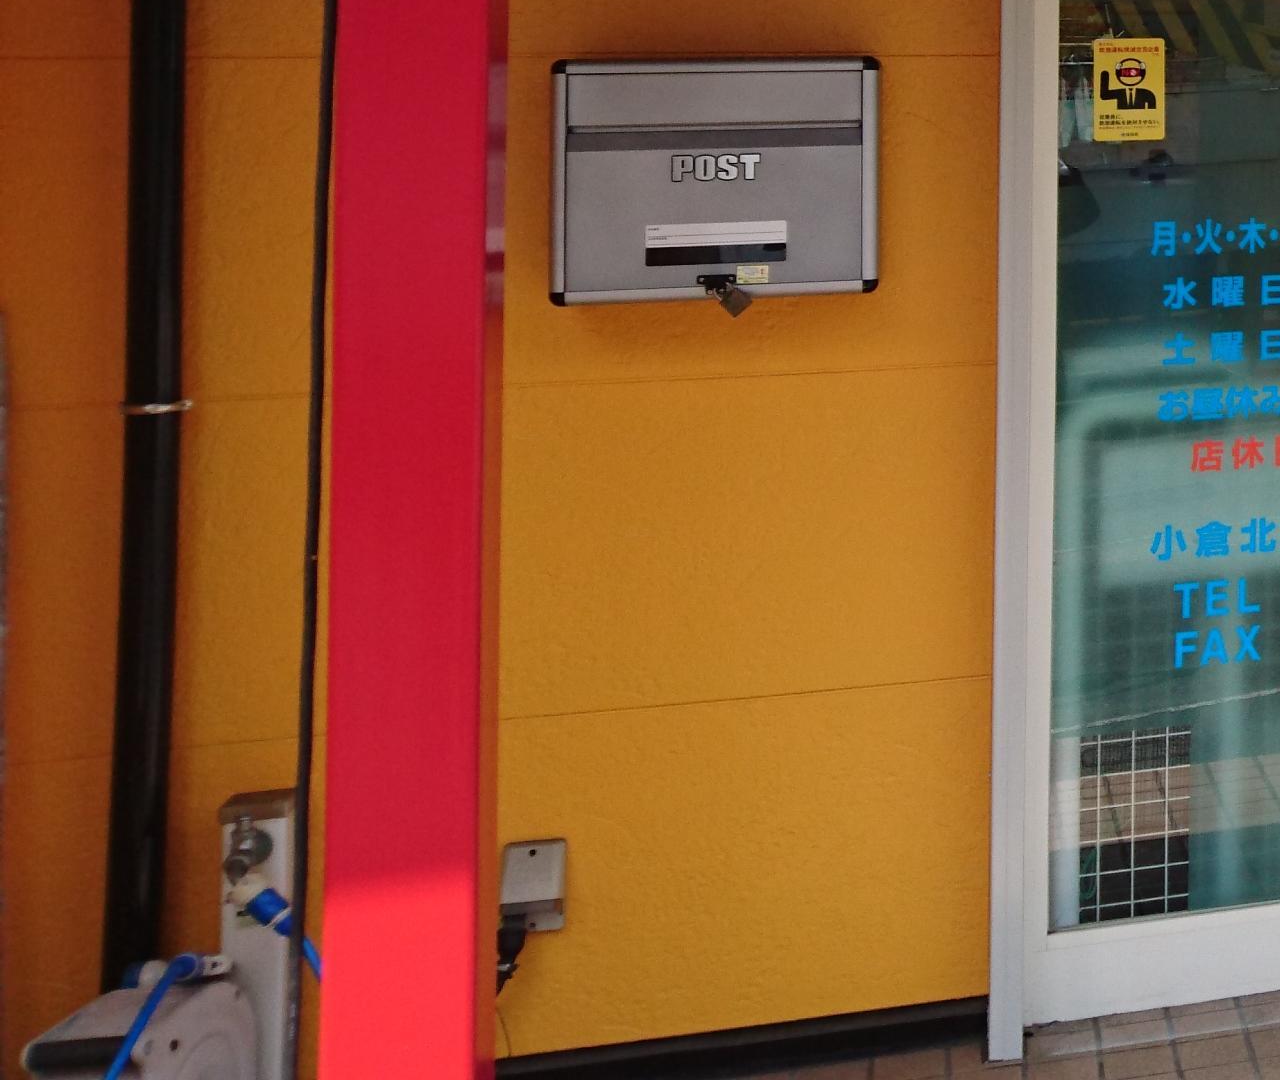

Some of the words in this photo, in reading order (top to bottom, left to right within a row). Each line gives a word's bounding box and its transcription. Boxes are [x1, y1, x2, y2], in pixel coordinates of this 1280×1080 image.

[670, 152, 762, 183] POST
[1173, 578, 1261, 619] TEL
[1173, 624, 1262, 669] FAX
